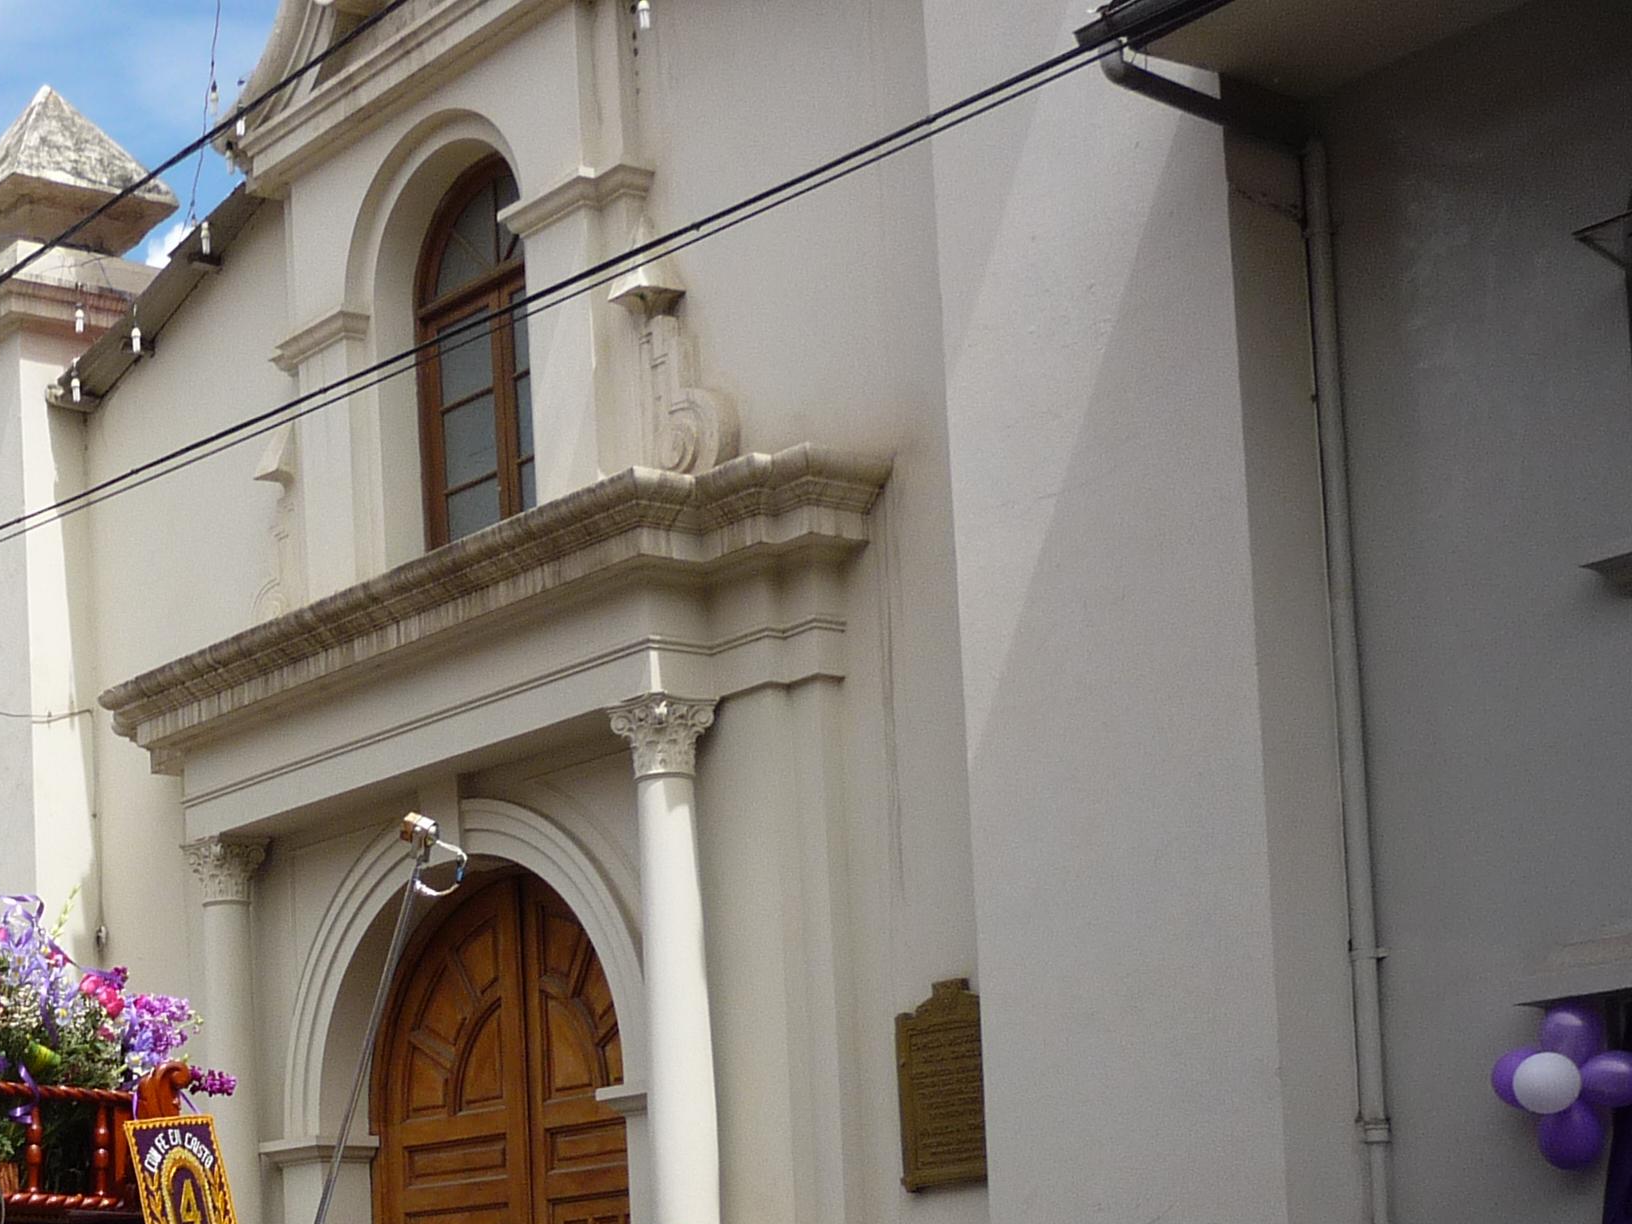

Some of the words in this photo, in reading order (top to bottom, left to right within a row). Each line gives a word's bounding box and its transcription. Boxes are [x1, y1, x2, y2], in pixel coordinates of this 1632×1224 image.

[144, 1146, 162, 1173] CON
[154, 1132, 170, 1154] FE
[168, 1129, 182, 1146] EN
[184, 1132, 214, 1169] CRISTO
